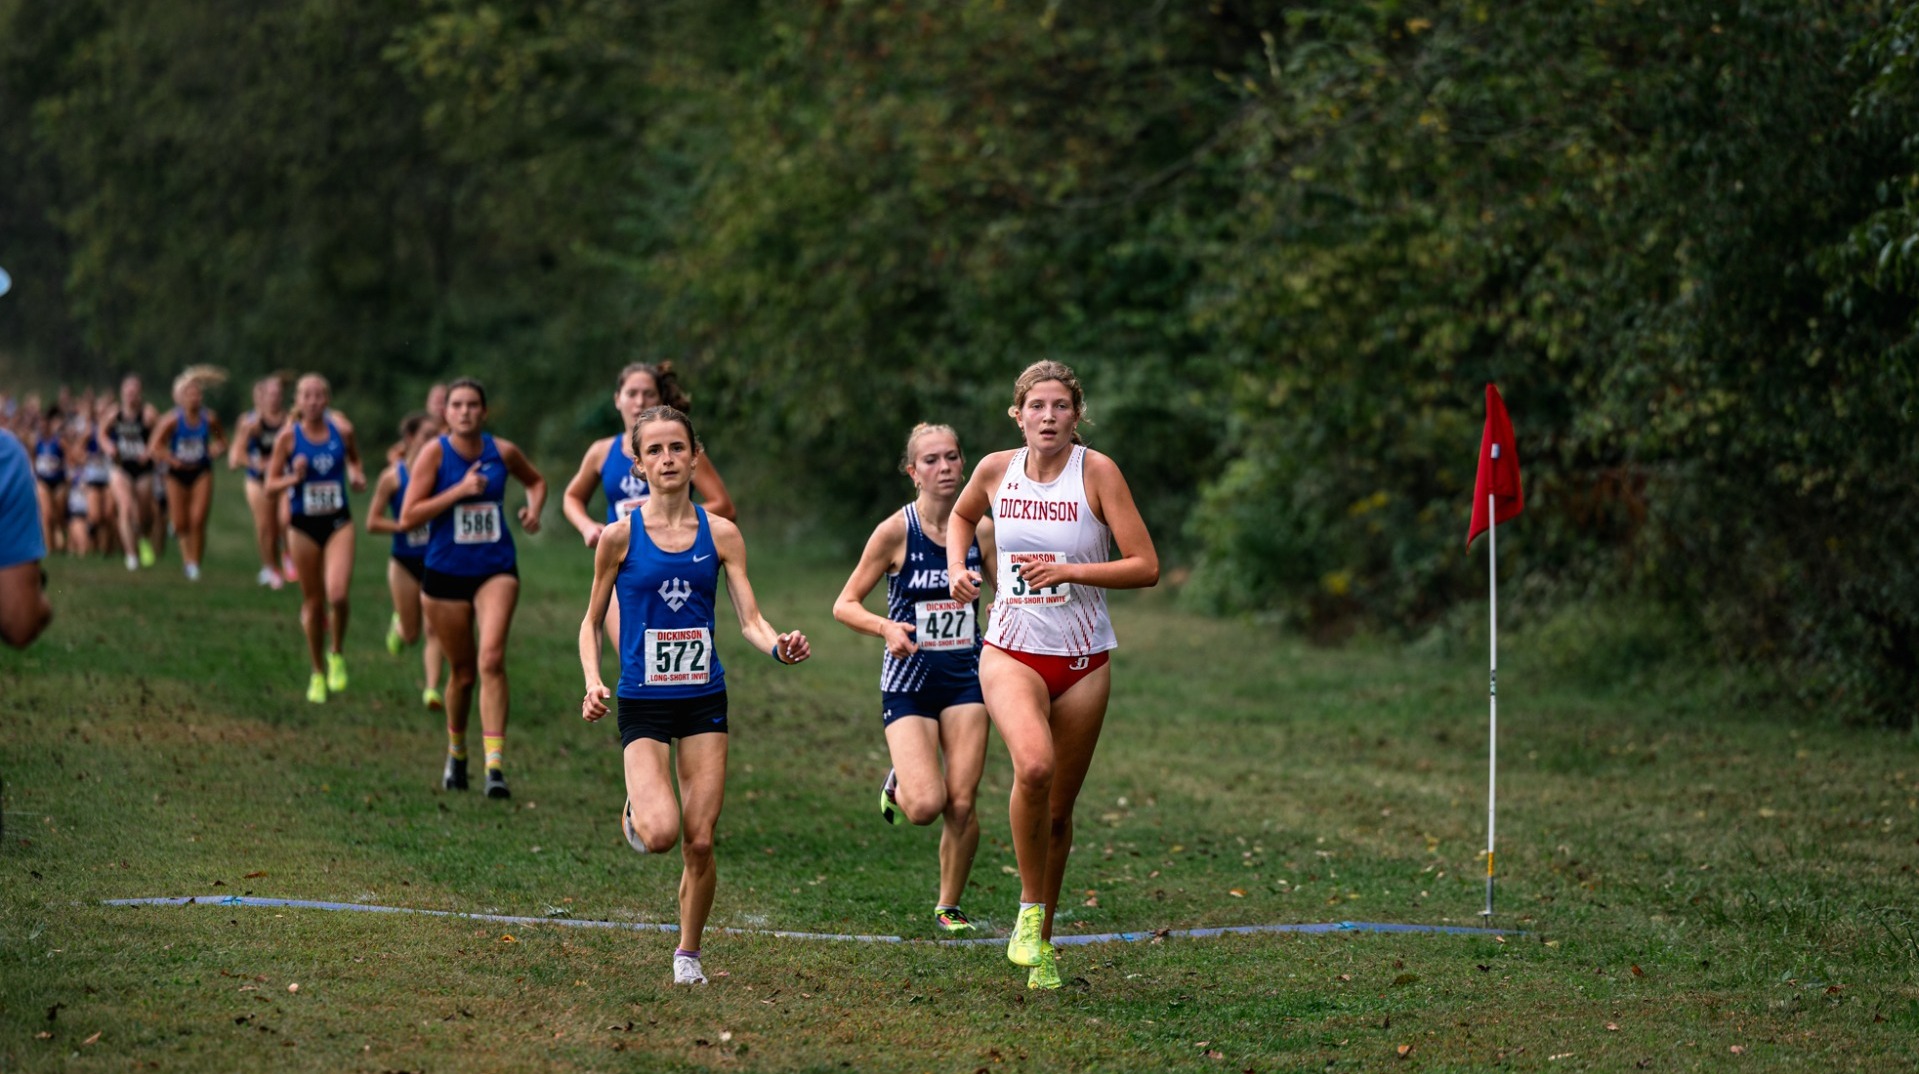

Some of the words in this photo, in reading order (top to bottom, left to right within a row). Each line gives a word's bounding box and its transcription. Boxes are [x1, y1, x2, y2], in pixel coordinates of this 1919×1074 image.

[999, 498, 1079, 522] DICKINSON
[657, 630, 703, 641] DICKINSON
[925, 611, 967, 640] 427
[656, 640, 705, 673] 572
[650, 673, 689, 682] LONG-SHORT
